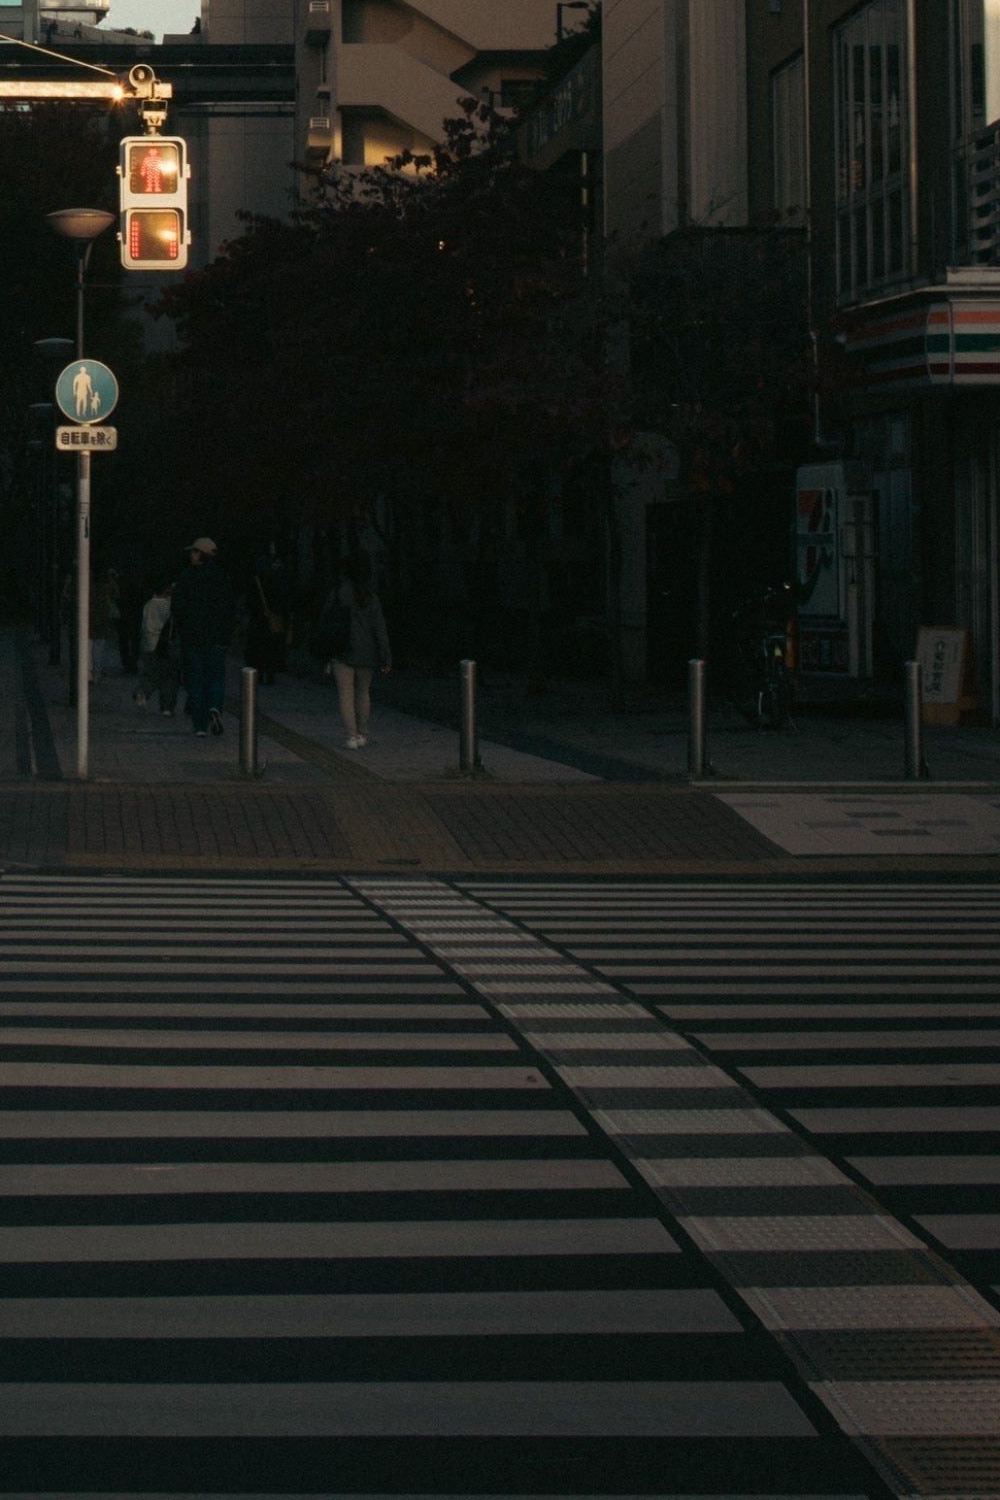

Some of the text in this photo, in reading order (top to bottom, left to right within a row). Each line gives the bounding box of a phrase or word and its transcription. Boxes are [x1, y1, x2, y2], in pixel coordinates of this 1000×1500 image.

[61, 431, 111, 445] 自転車を除く
